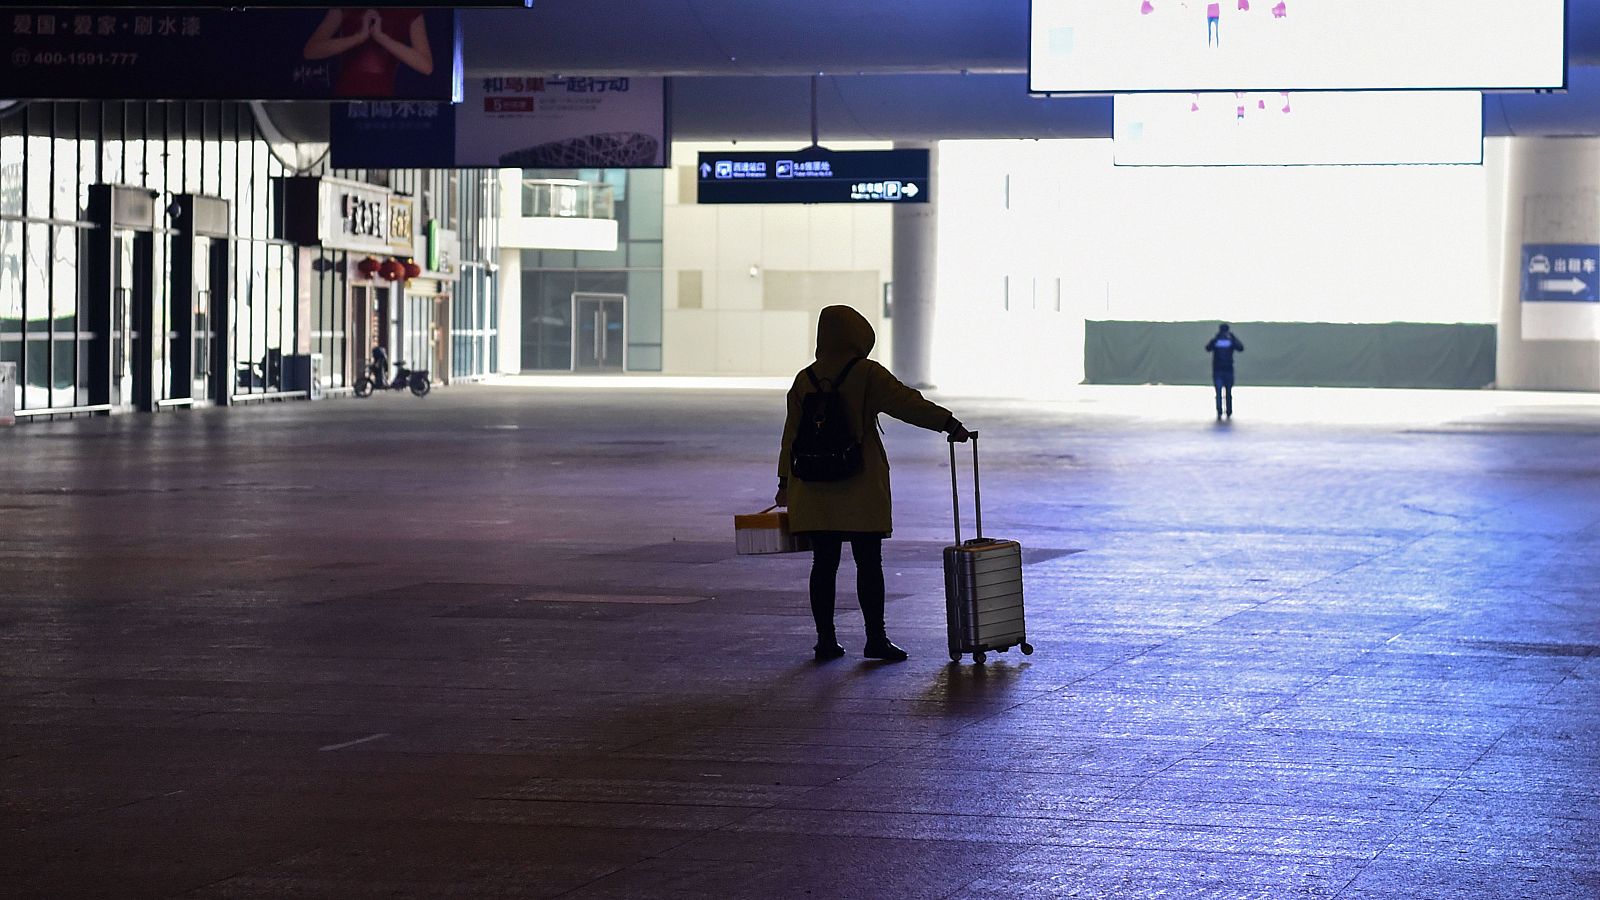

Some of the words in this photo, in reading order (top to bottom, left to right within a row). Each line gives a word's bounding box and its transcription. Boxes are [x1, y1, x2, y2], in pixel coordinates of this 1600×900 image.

[34, 52, 138, 65] 400-1591-777
[1554, 257, 1596, 274] 出租车
